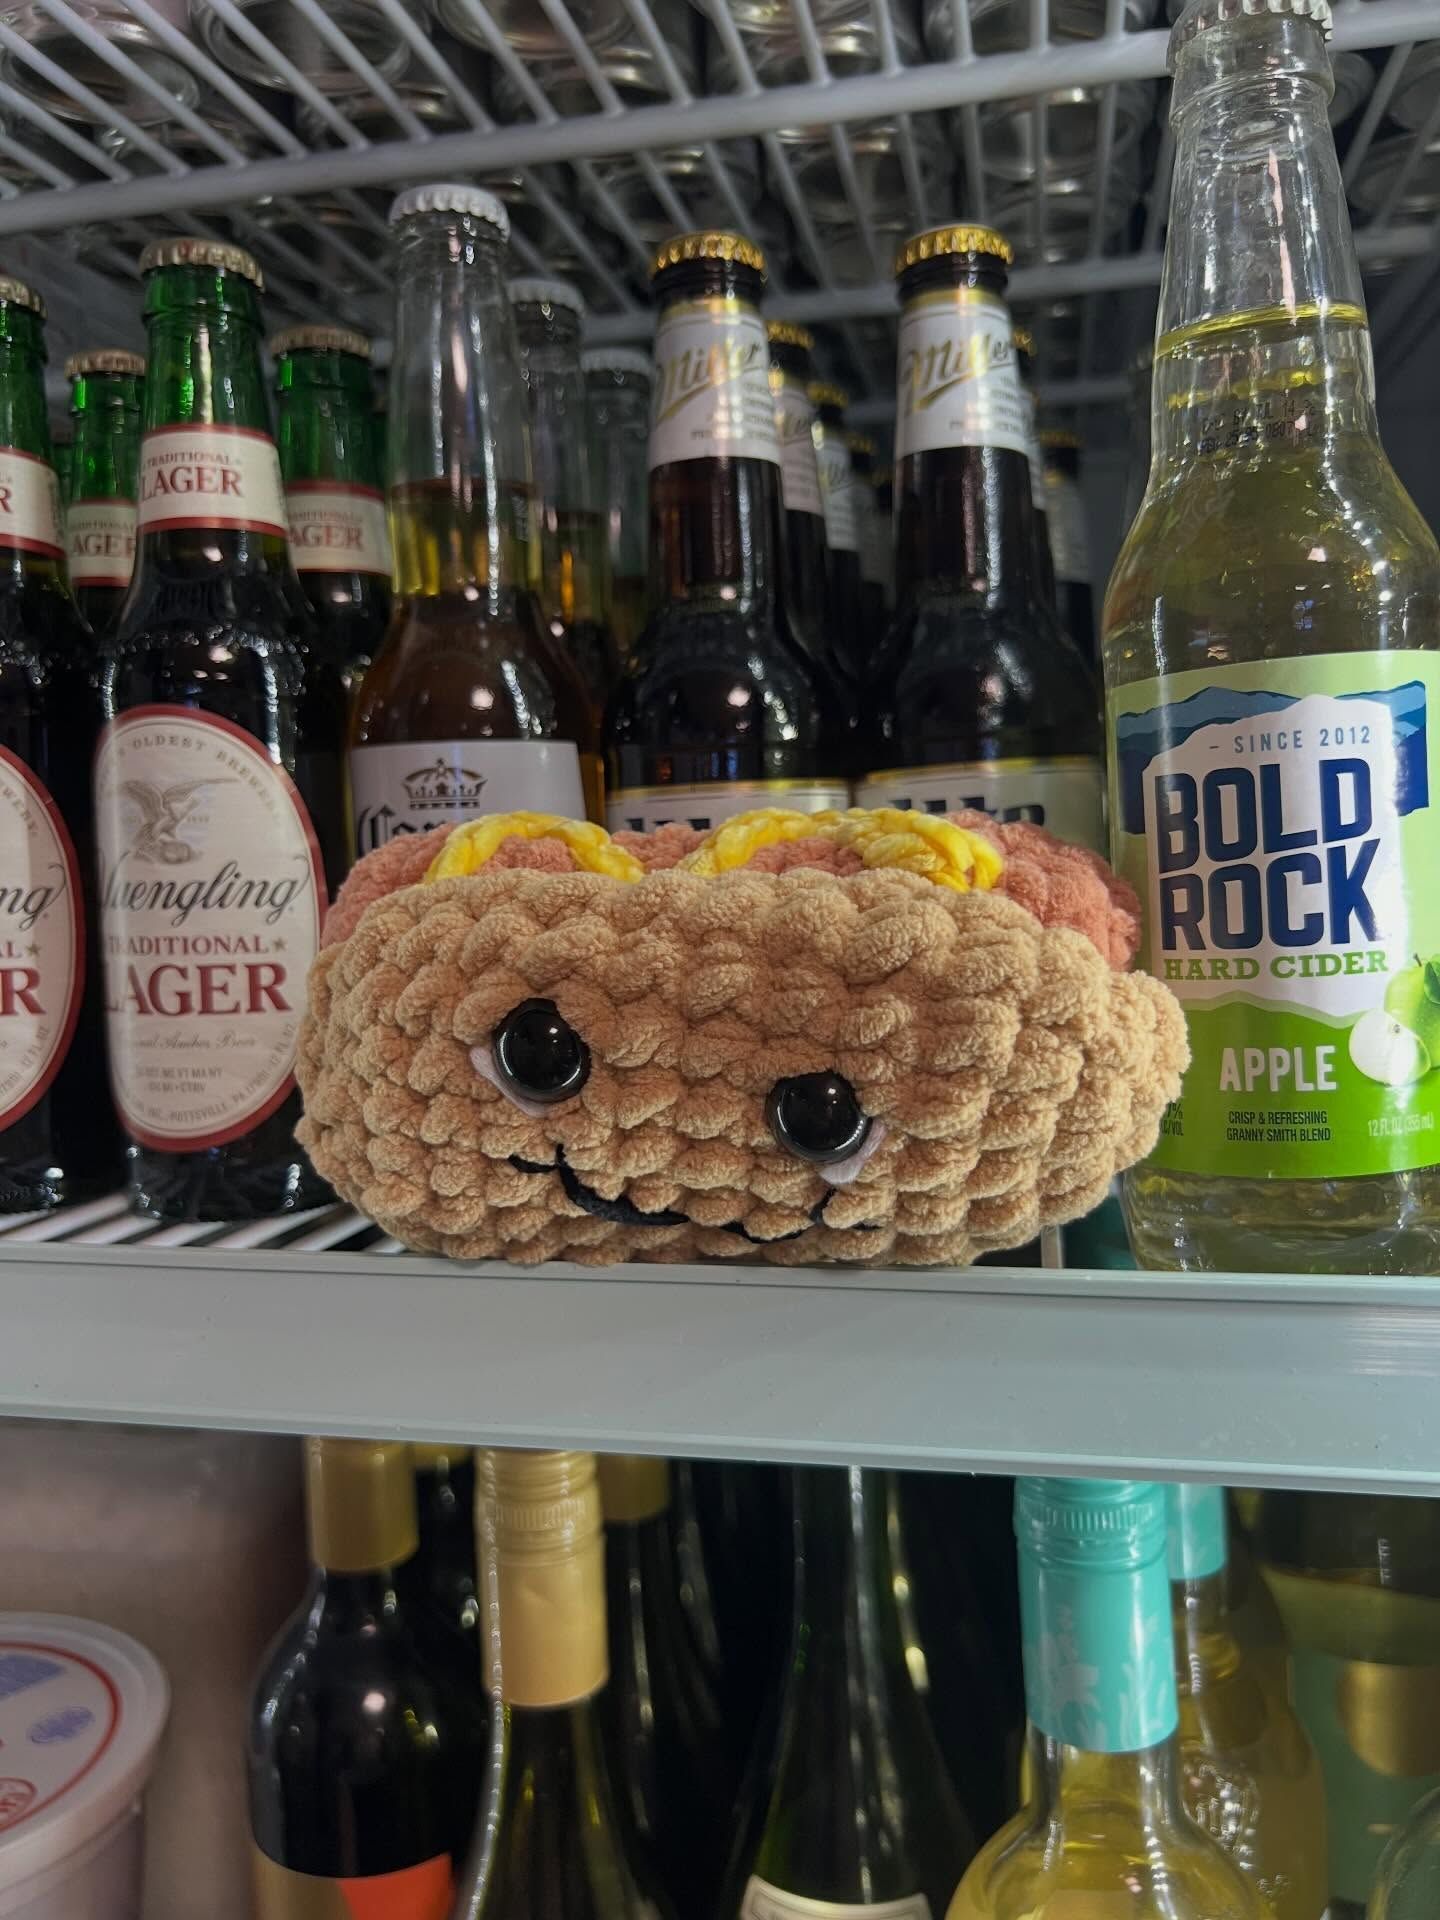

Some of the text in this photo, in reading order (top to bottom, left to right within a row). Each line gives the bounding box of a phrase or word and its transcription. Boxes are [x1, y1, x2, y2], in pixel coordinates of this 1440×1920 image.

[141, 465, 245, 501] LAGER
[288, 524, 364, 551] AGER
[132, 734, 208, 751] OLDEST
[1234, 725, 1371, 754] SINCE 2012
[1154, 757, 1373, 874] BOLD
[1159, 838, 1382, 951] ROCK
[1163, 950, 1390, 982] HARD CIDER
[1219, 1045, 1339, 1093] APPLE
[1228, 1111, 1328, 1125] CRISP & REFRESHING
[1226, 1127, 1331, 1142] GRANNY SMITH BLEND
